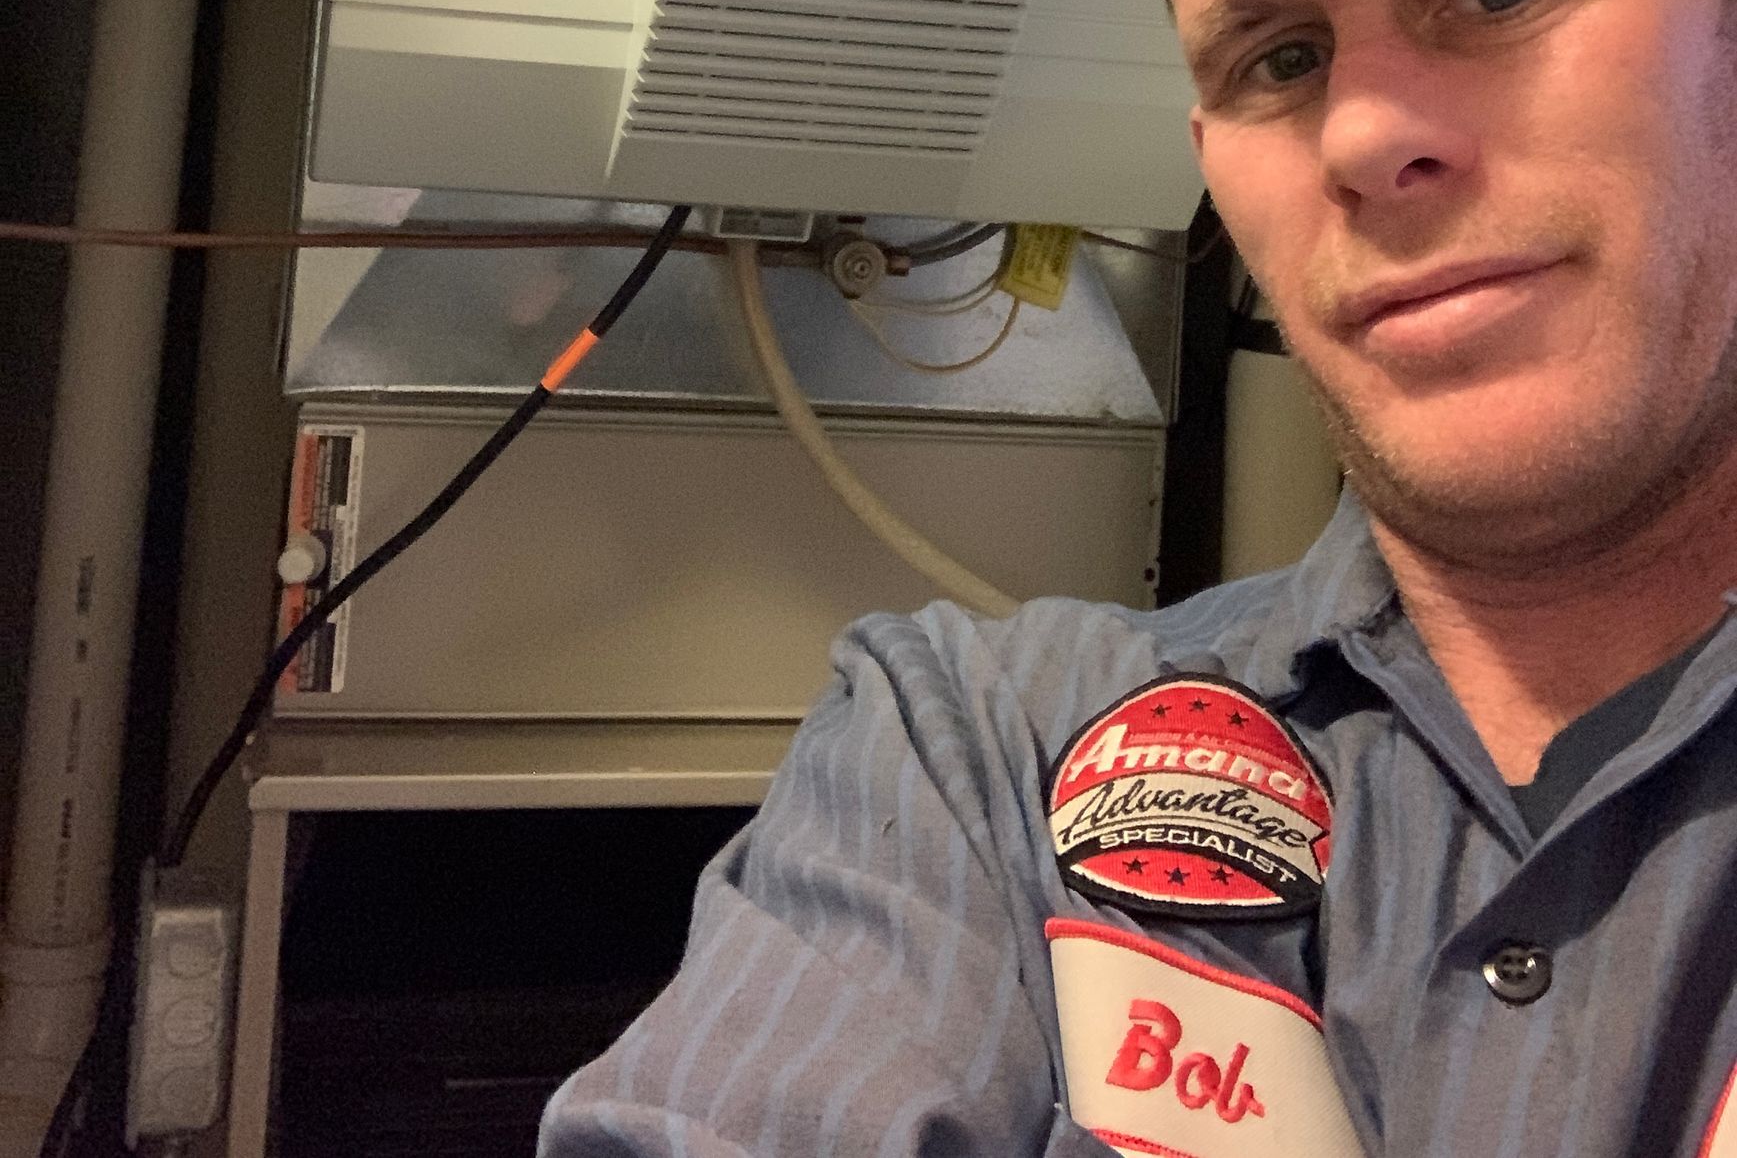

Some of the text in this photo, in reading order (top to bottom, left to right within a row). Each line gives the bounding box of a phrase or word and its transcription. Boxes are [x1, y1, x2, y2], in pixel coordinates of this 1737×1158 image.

[1066, 723, 1308, 801] Amana
[1057, 778, 1308, 848] Advantage
[1099, 828, 1297, 883] SPECIALIST
[1105, 998, 1266, 1124] Bob
